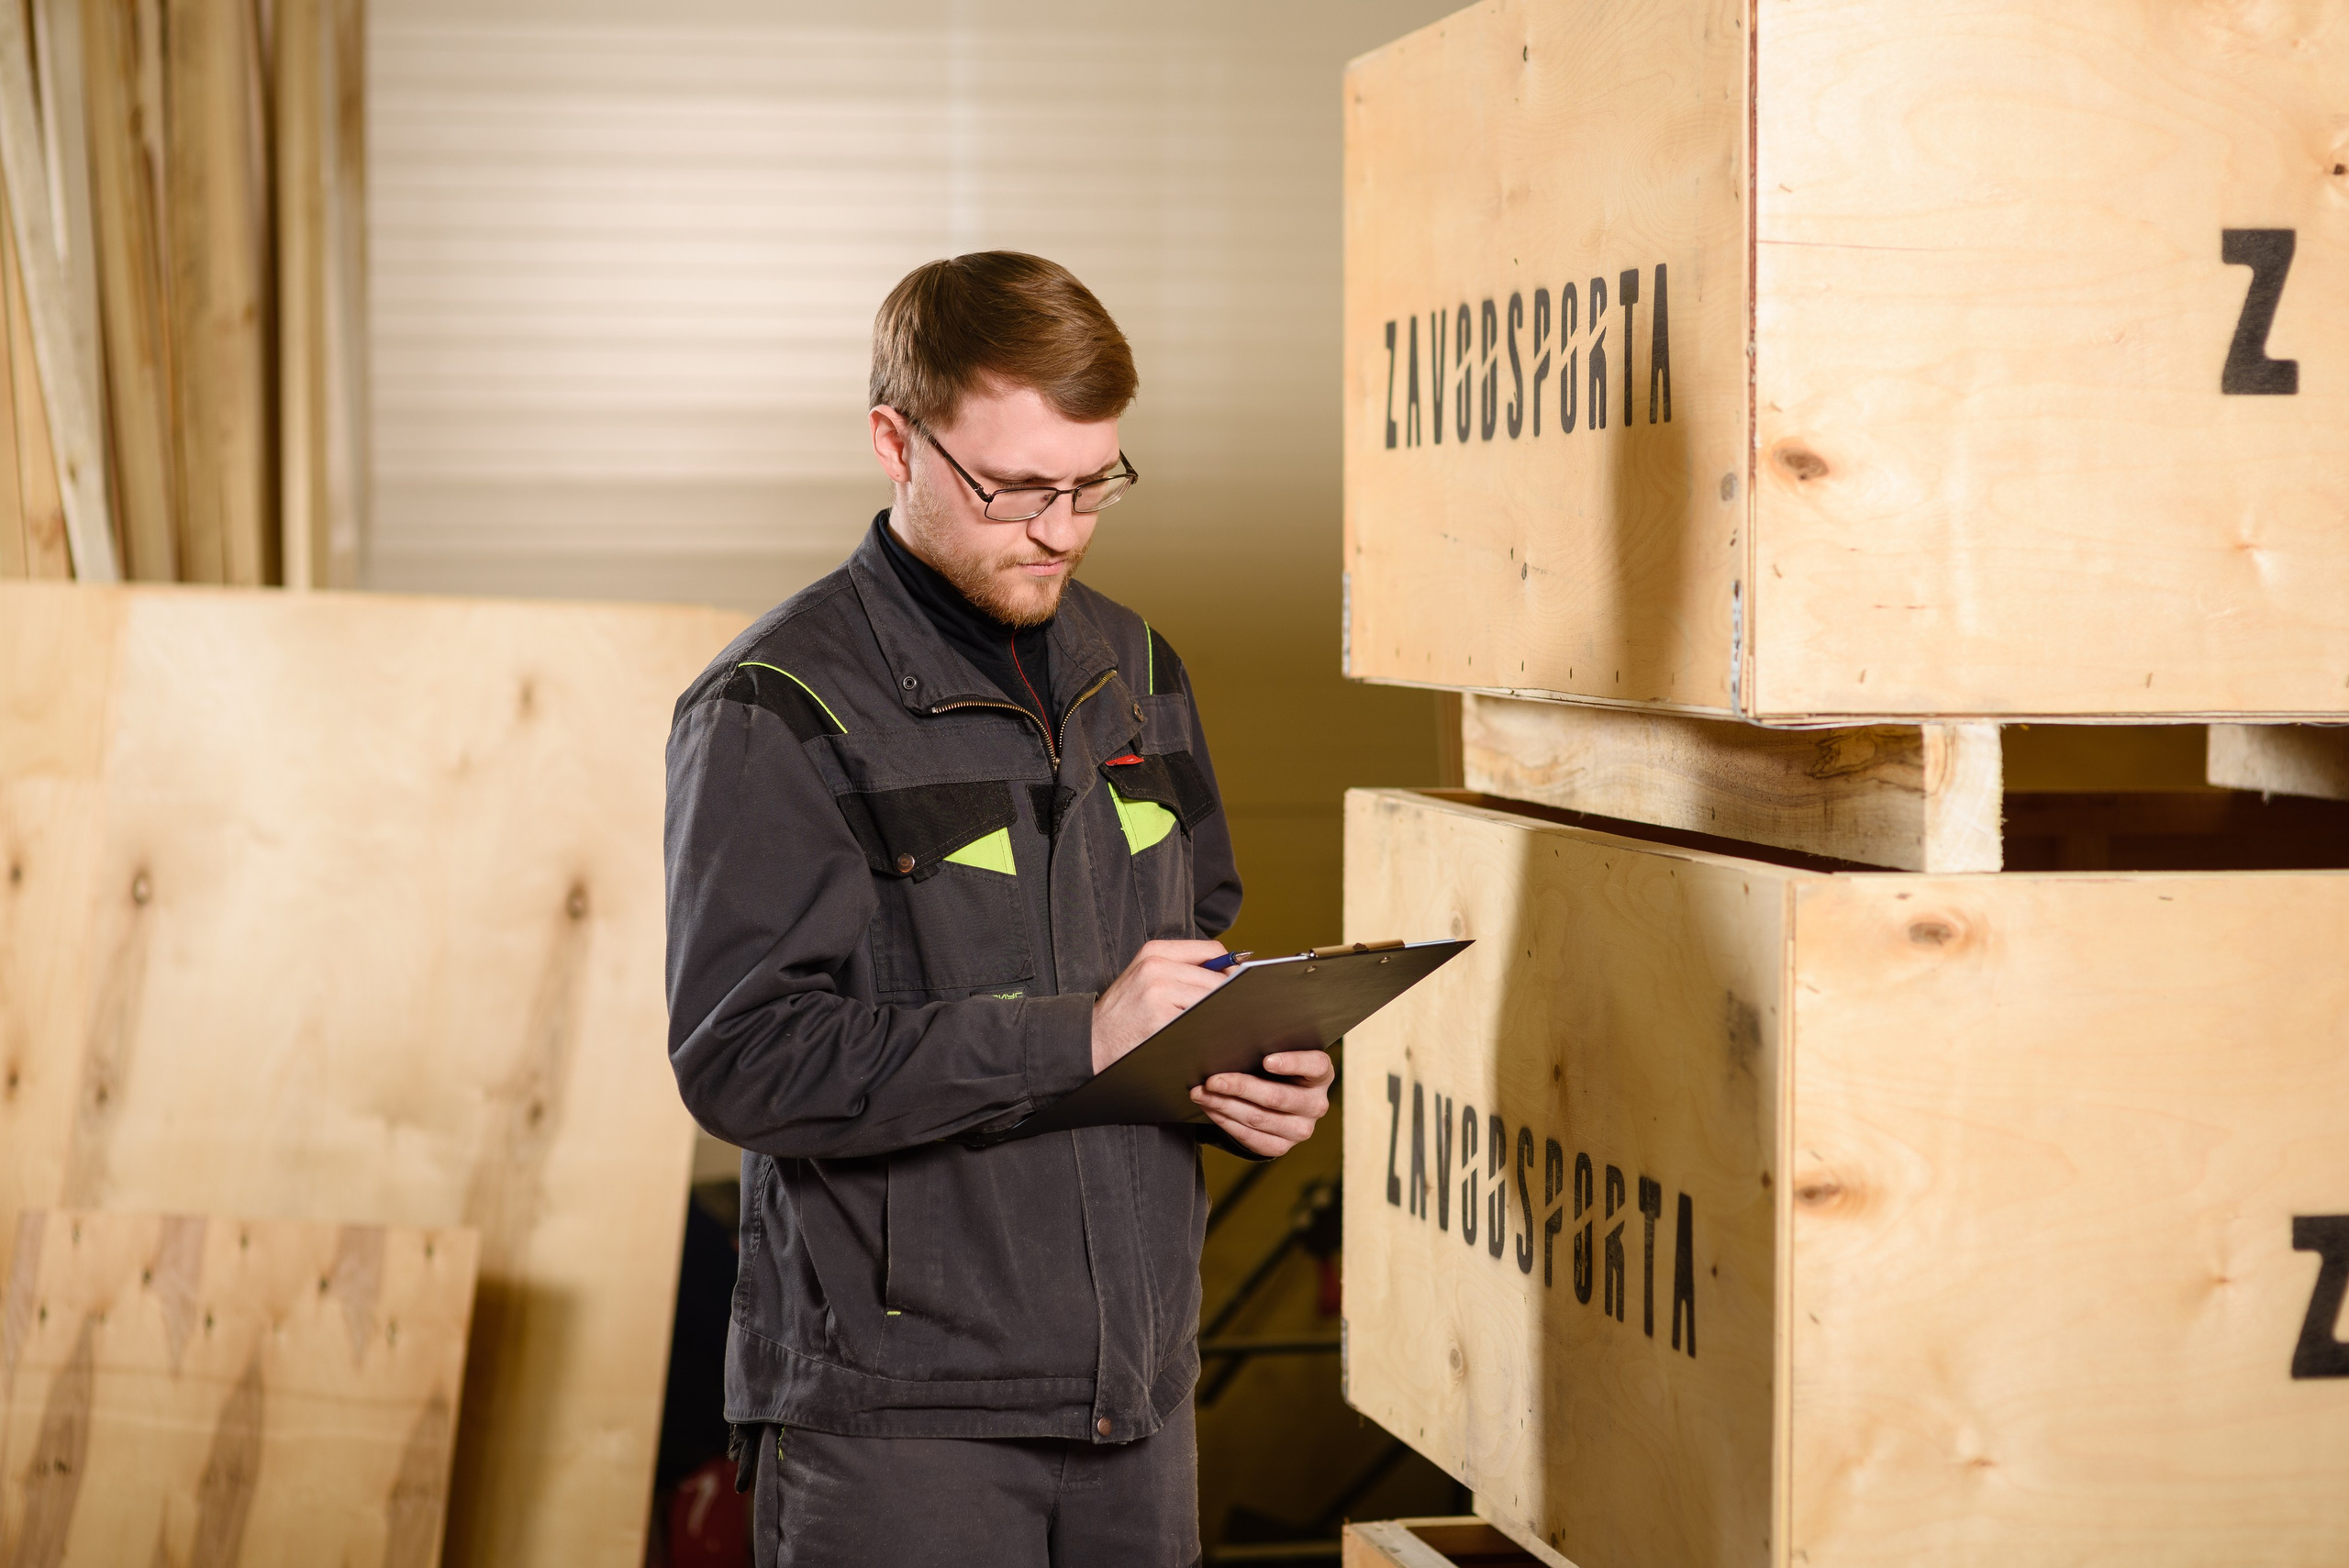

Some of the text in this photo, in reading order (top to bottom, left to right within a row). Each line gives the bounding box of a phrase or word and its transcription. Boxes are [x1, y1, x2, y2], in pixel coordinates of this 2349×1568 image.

[1385, 262, 1672, 450] ZAVODSPORTA
[2221, 228, 2299, 395] Z
[1386, 1073, 1697, 1359] ZAVODSPORTA
